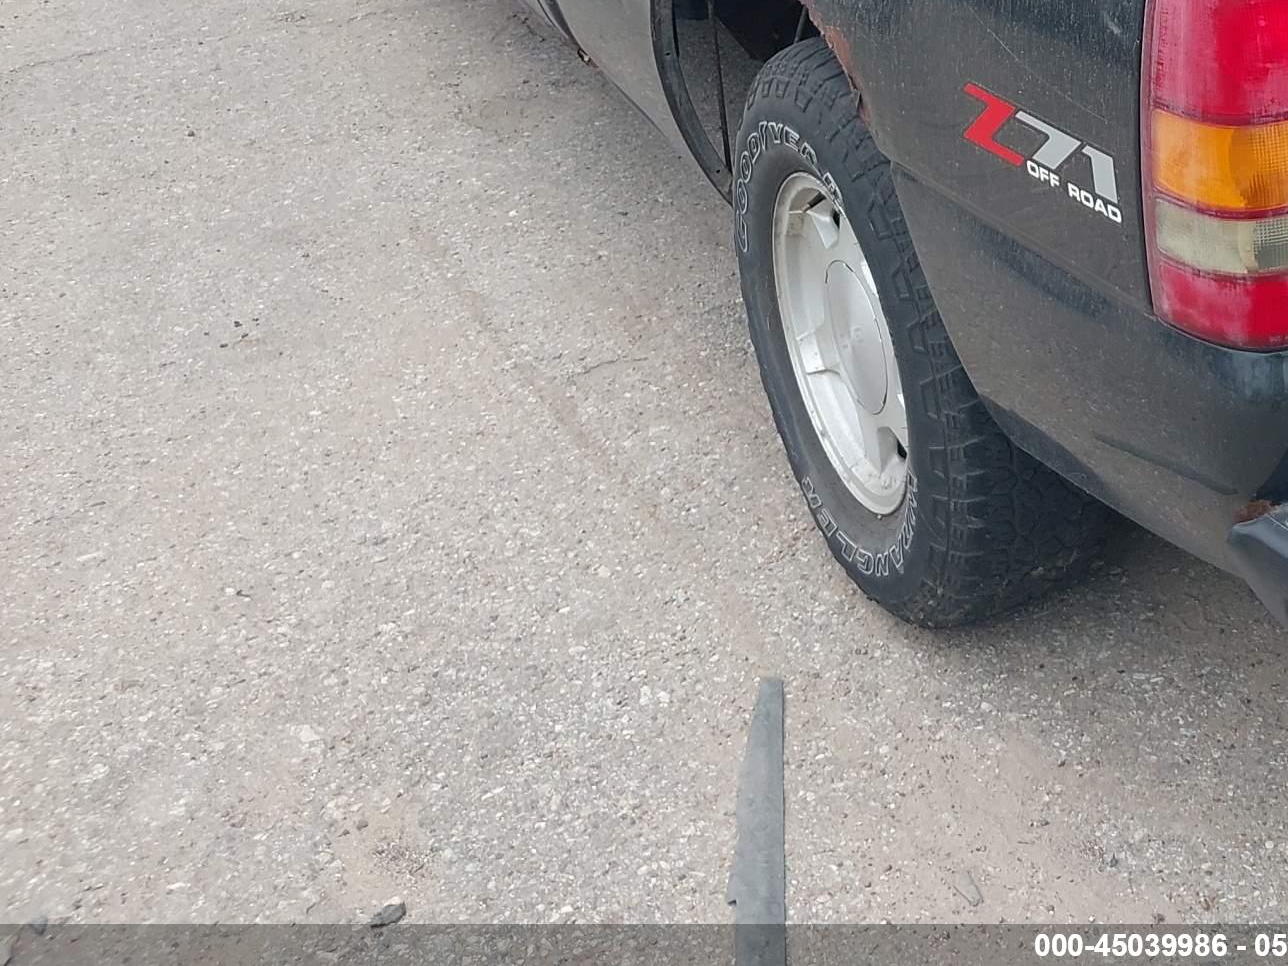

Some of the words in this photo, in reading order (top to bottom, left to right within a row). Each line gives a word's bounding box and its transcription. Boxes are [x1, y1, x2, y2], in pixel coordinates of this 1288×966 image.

[963, 81, 1118, 204] Z71
[1025, 158, 1061, 188] OFF
[1066, 181, 1122, 224] ROAD
[801, 467, 918, 577] WRANGLER
